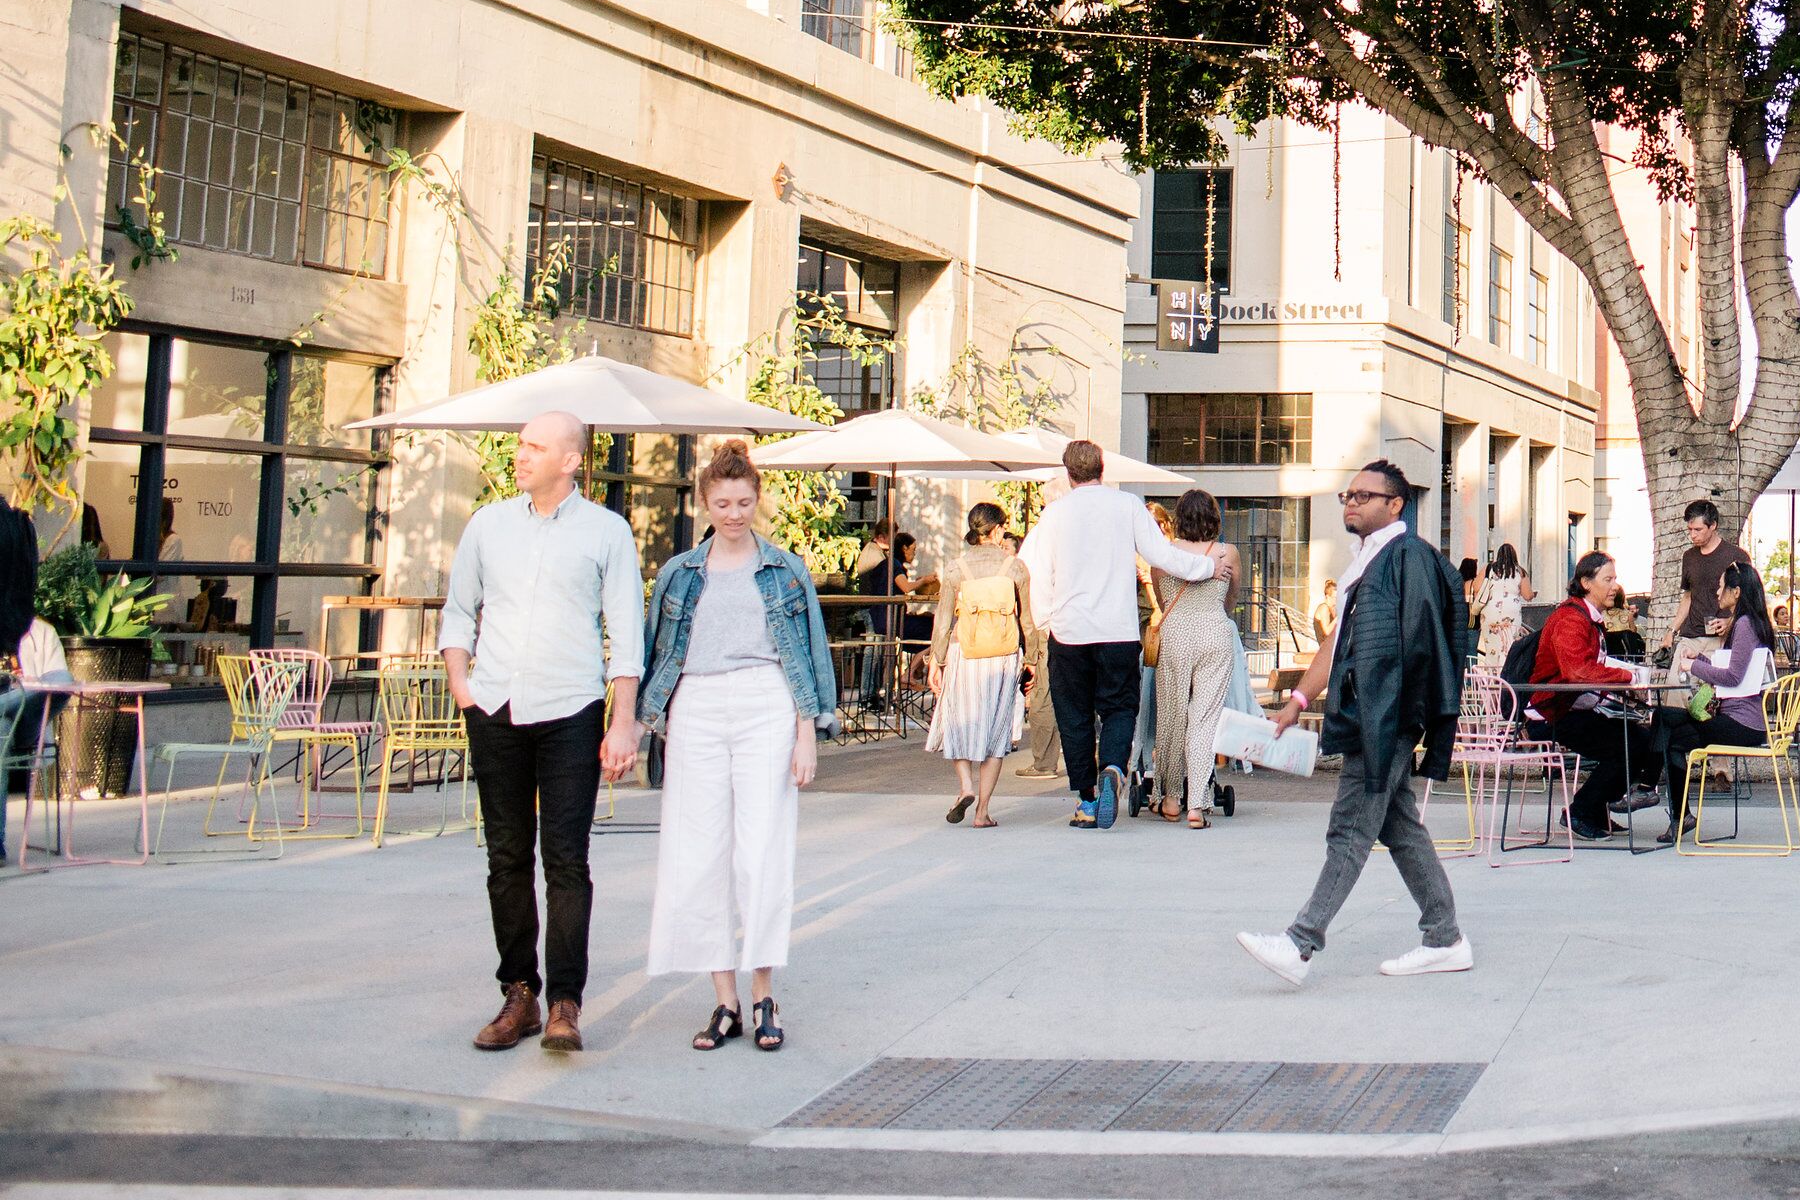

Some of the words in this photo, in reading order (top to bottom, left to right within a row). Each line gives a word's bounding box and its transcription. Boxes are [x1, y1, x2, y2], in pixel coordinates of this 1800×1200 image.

[1284, 302, 1365, 320] Street
[129, 474, 179, 489] Tzo
[197, 501, 233, 517] TENZO
